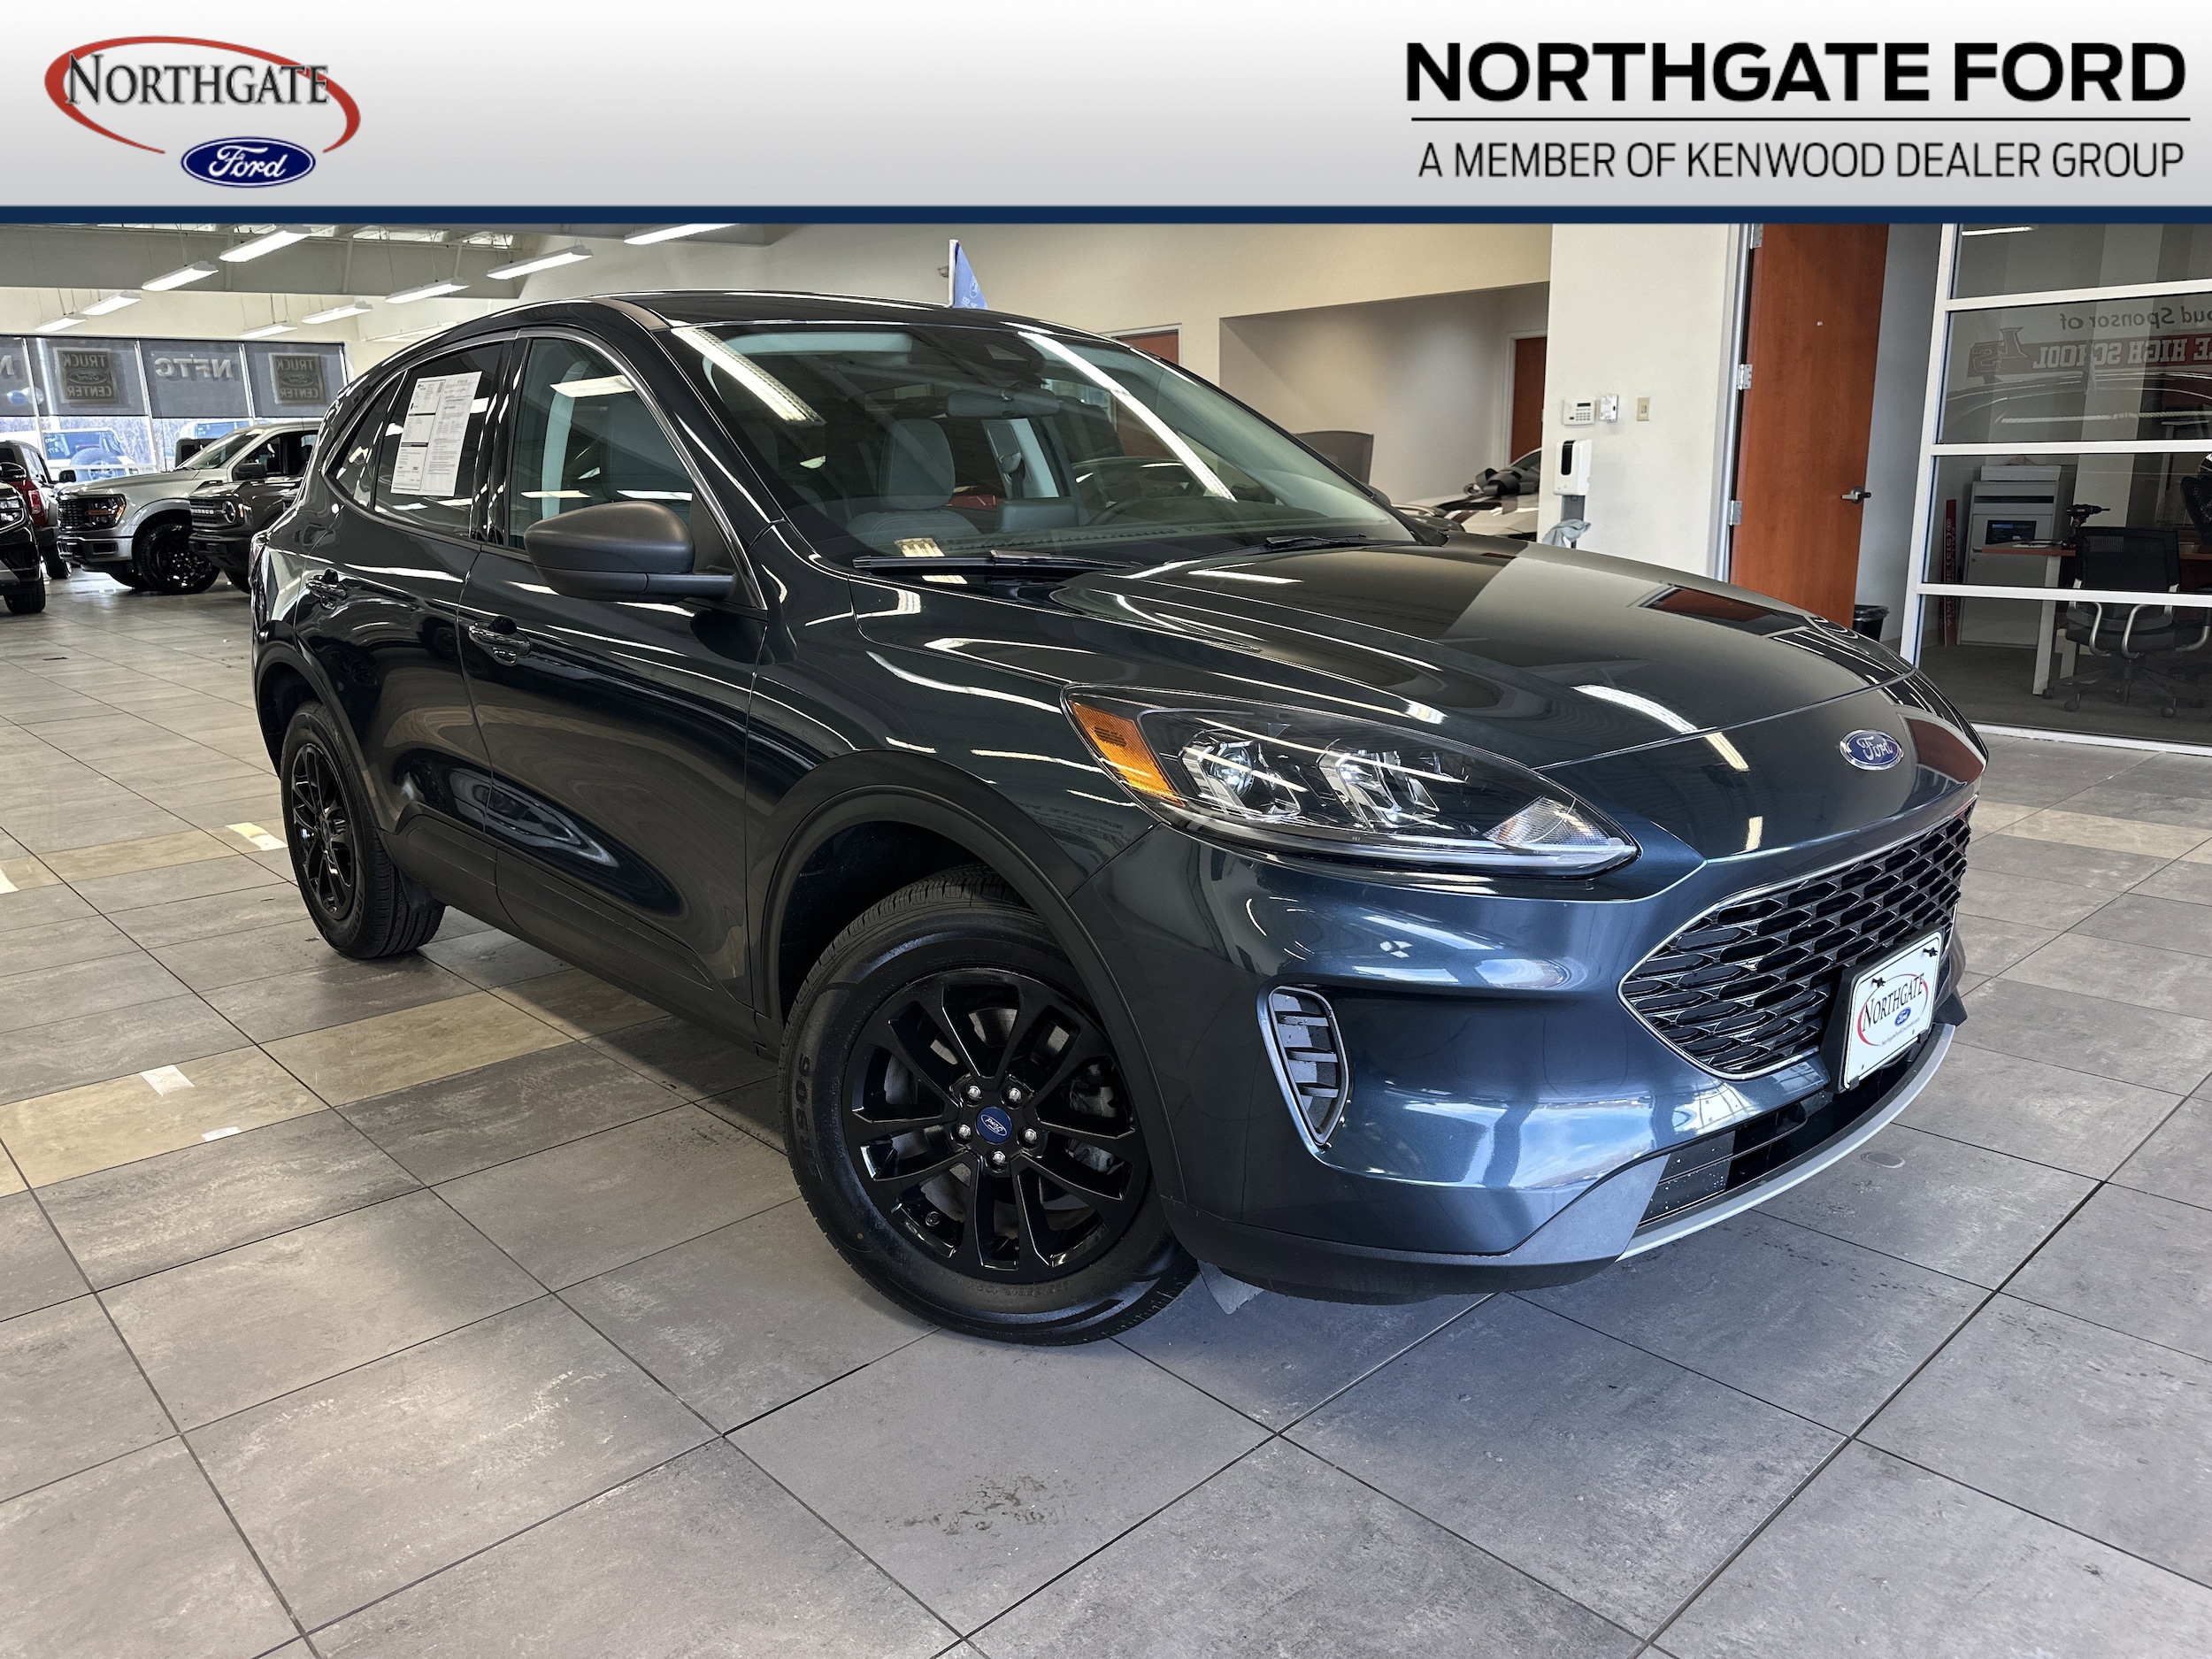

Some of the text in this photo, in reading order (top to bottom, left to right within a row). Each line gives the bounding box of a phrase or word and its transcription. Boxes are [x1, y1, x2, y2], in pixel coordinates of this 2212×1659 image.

[1855, 735, 1893, 761] Ford
[1862, 972, 1924, 1033] NORTHGATE
[983, 1118, 1004, 1133] Ford
